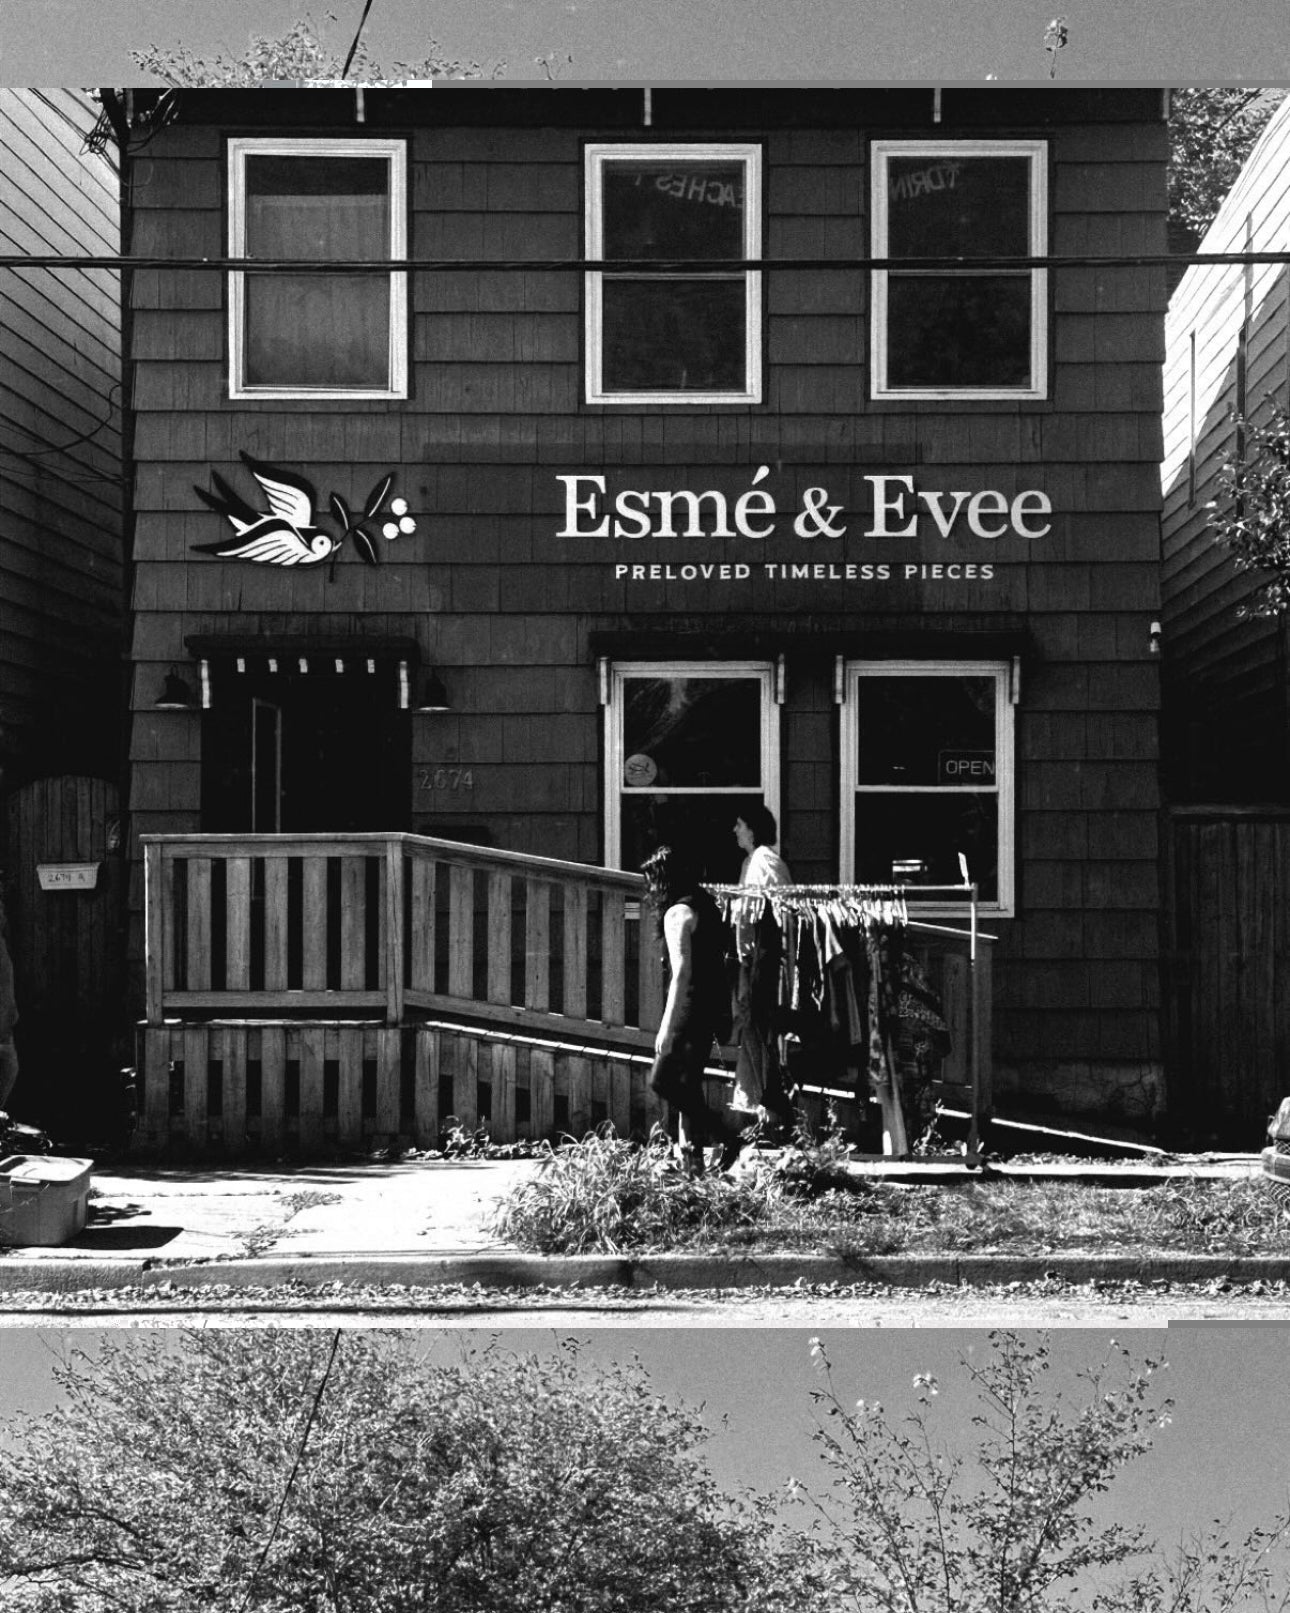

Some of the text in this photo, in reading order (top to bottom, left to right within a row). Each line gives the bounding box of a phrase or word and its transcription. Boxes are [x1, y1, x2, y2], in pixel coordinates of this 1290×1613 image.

[555, 465, 1053, 539] Esmé & Evee
[614, 564, 996, 580] PRELOVED TIMELESS PIECES
[945, 759, 996, 775] OPEN
[416, 768, 474, 790] 2674
